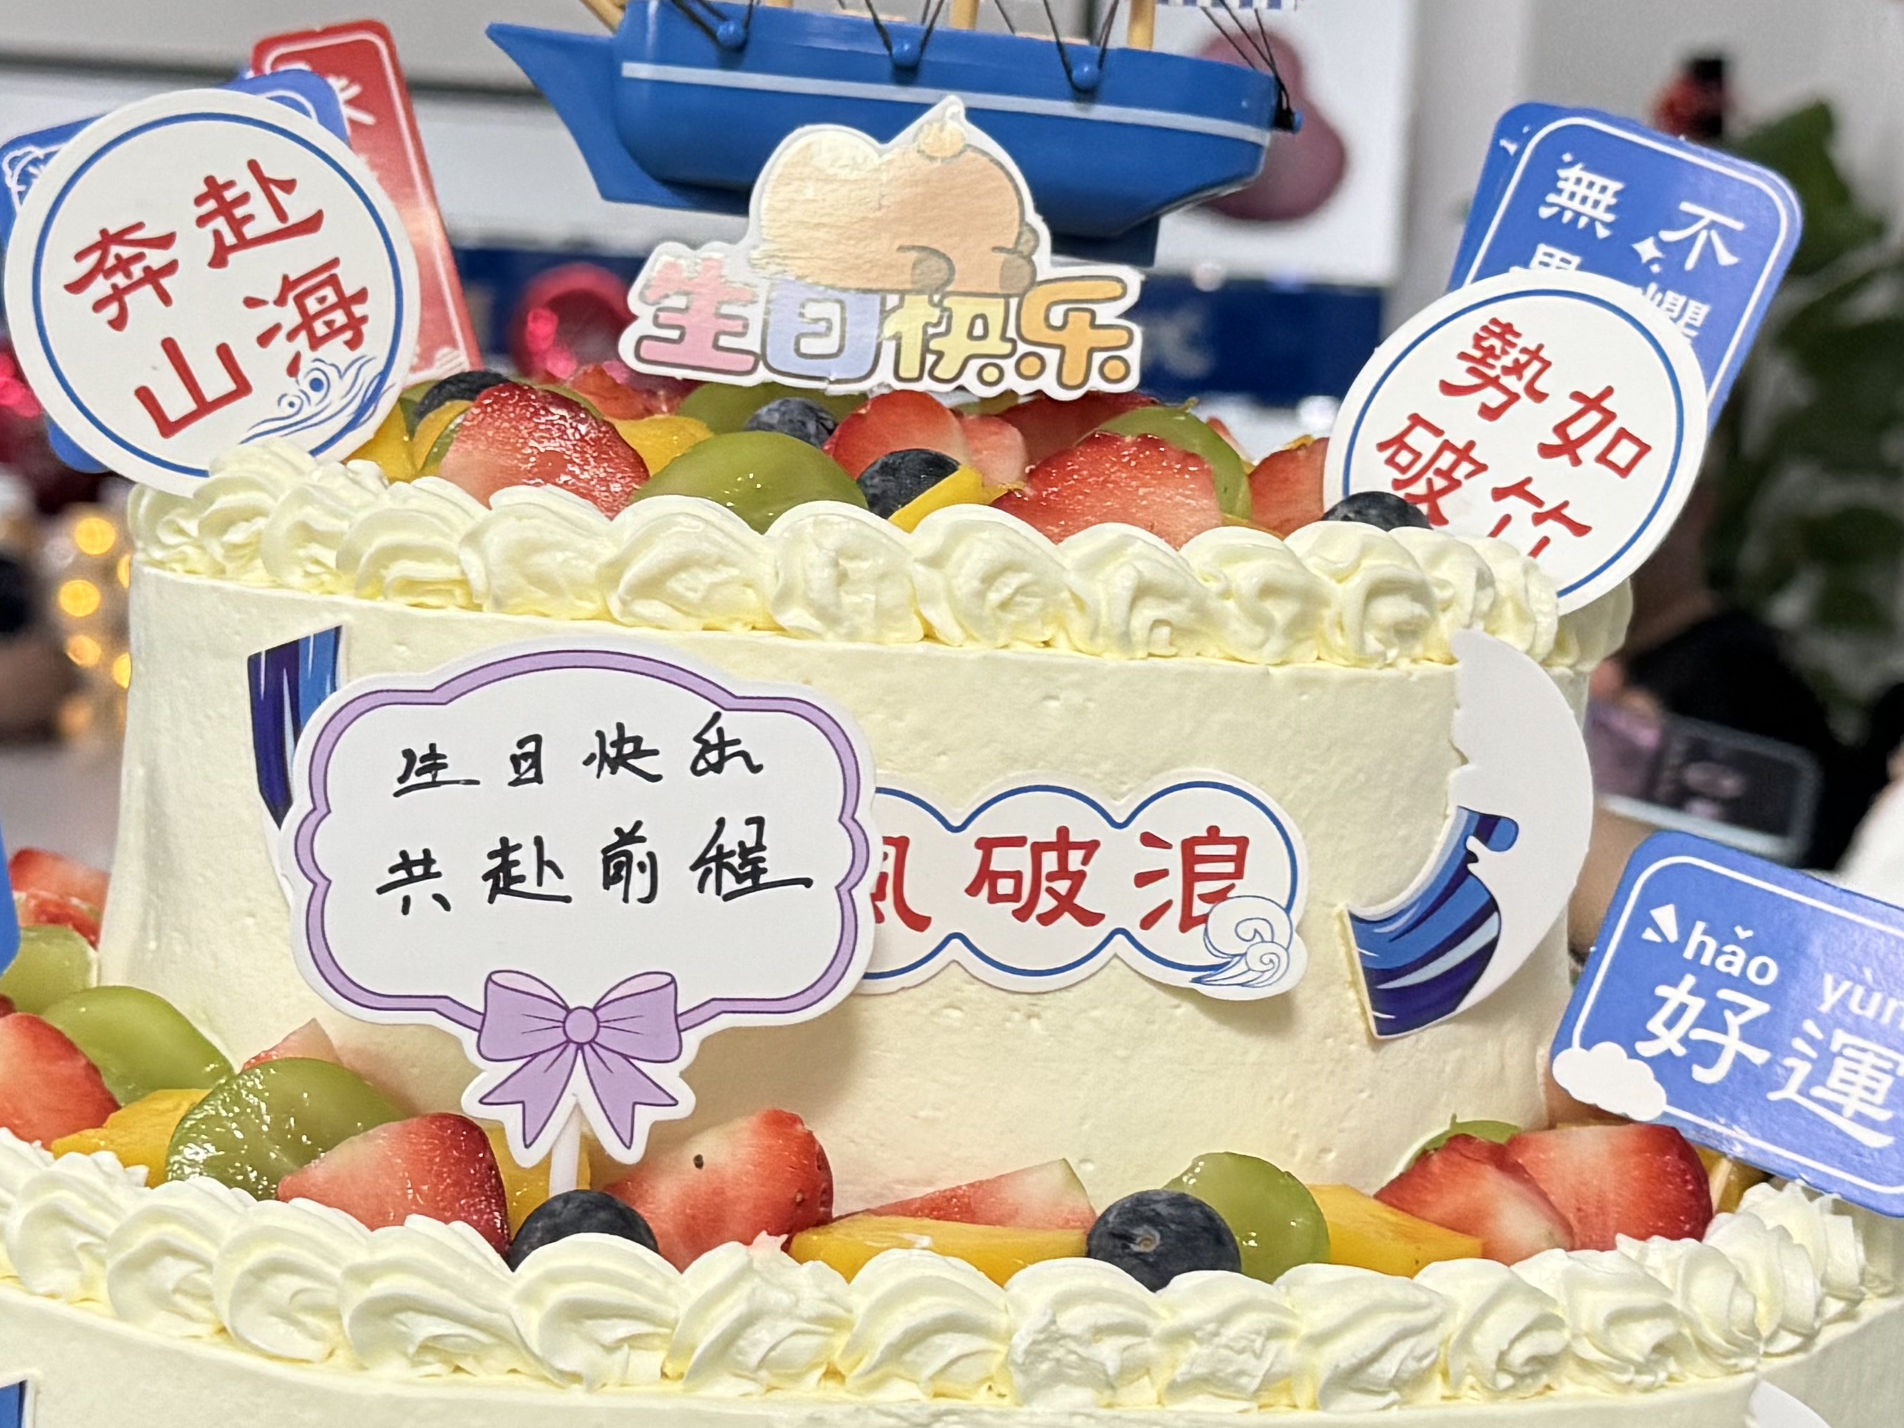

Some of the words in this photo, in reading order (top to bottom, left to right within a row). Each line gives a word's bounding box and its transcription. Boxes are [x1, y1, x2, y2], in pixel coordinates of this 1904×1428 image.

[62, 157, 326, 332] 奔赴
[133, 255, 369, 440] 山海
[634, 255, 1135, 391] 生日快乐
[1437, 316, 1653, 480] 勢如
[392, 710, 764, 798] 生日快乐
[375, 814, 814, 916] 共赴前程
[1682, 918, 1780, 988] hǎo
